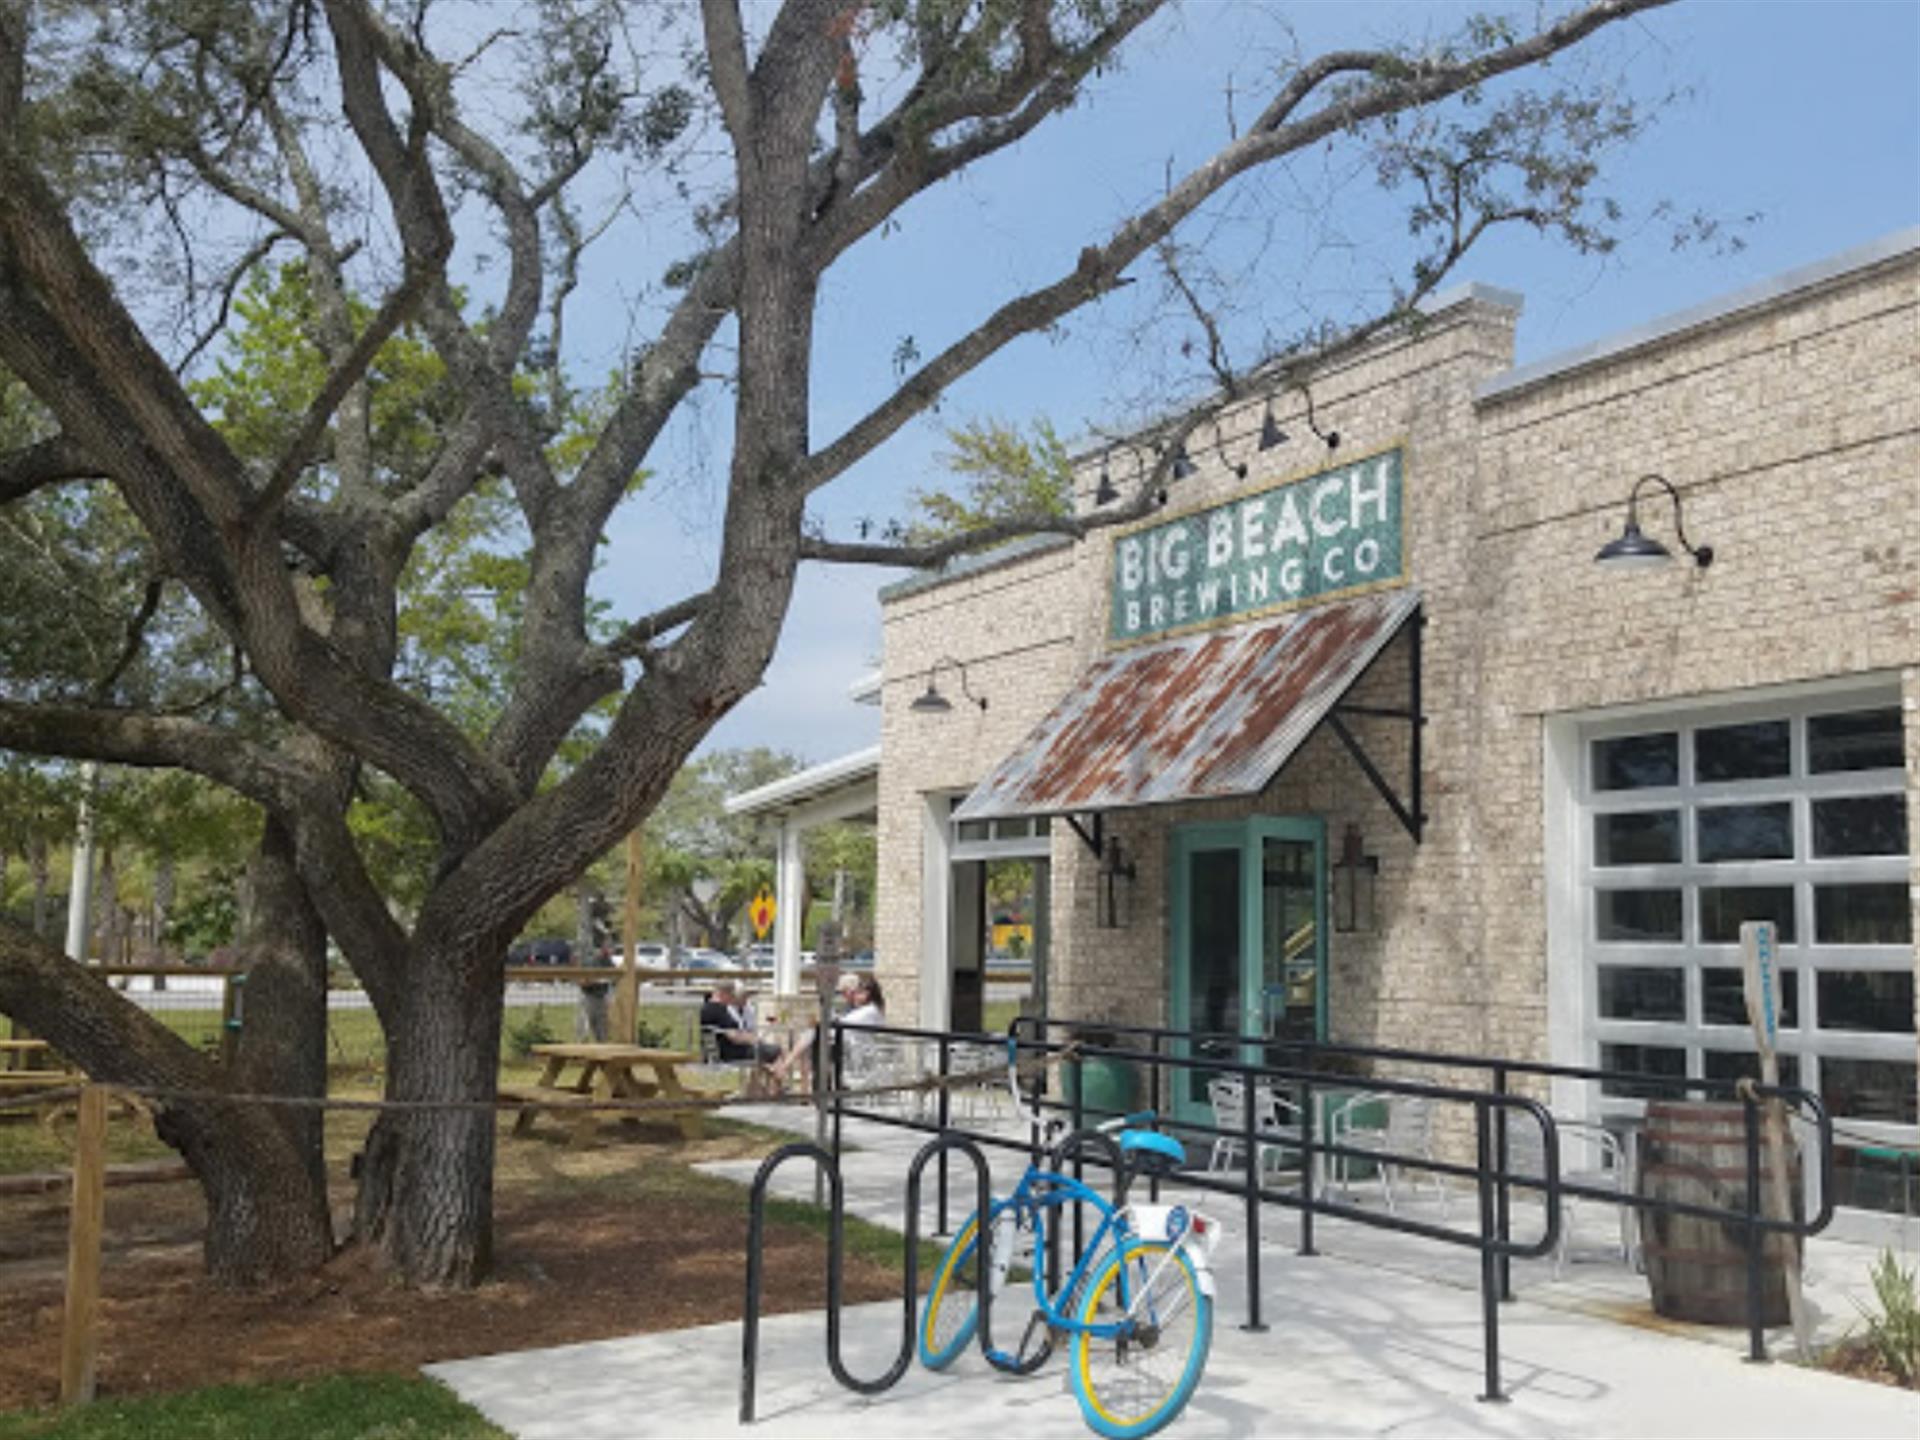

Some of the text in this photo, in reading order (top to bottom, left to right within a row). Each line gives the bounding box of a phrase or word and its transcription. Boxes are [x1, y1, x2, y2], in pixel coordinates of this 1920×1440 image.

[1120, 461, 1389, 591] BIG BEACH
[1125, 538, 1379, 631] BREWING CO
